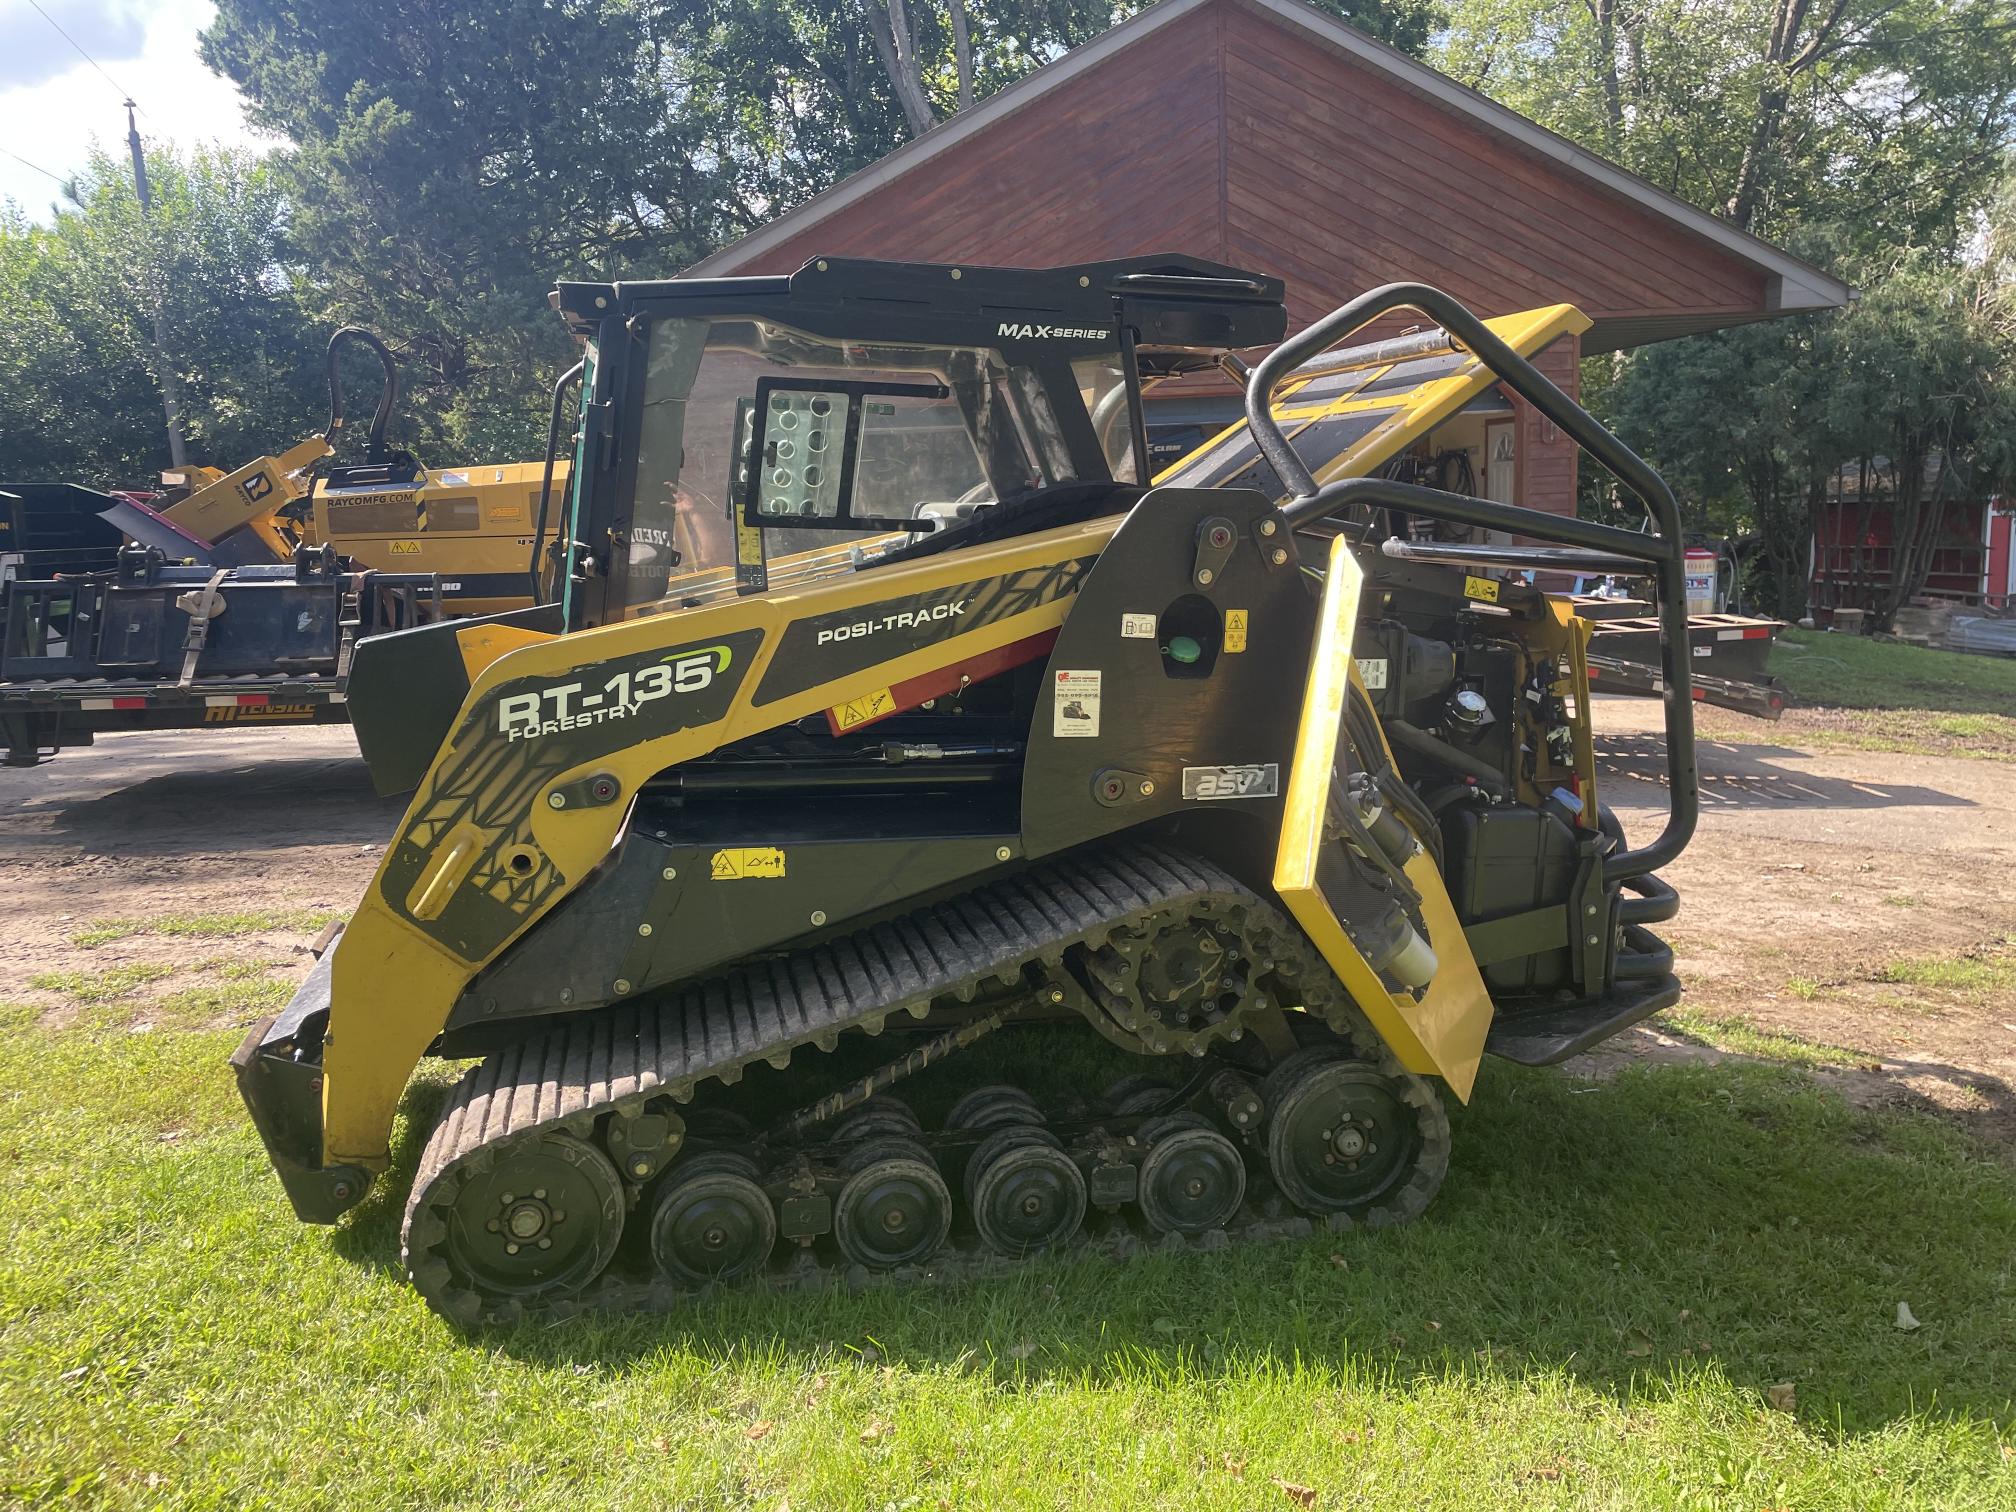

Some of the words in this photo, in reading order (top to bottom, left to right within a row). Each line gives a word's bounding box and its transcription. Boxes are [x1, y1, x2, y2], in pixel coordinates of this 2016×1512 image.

[327, 493, 414, 508] RAYCOMFG.COM
[817, 600, 966, 646] POSI-TRACK
[498, 655, 713, 732] RT-135
[508, 700, 644, 743] FORESTRY
